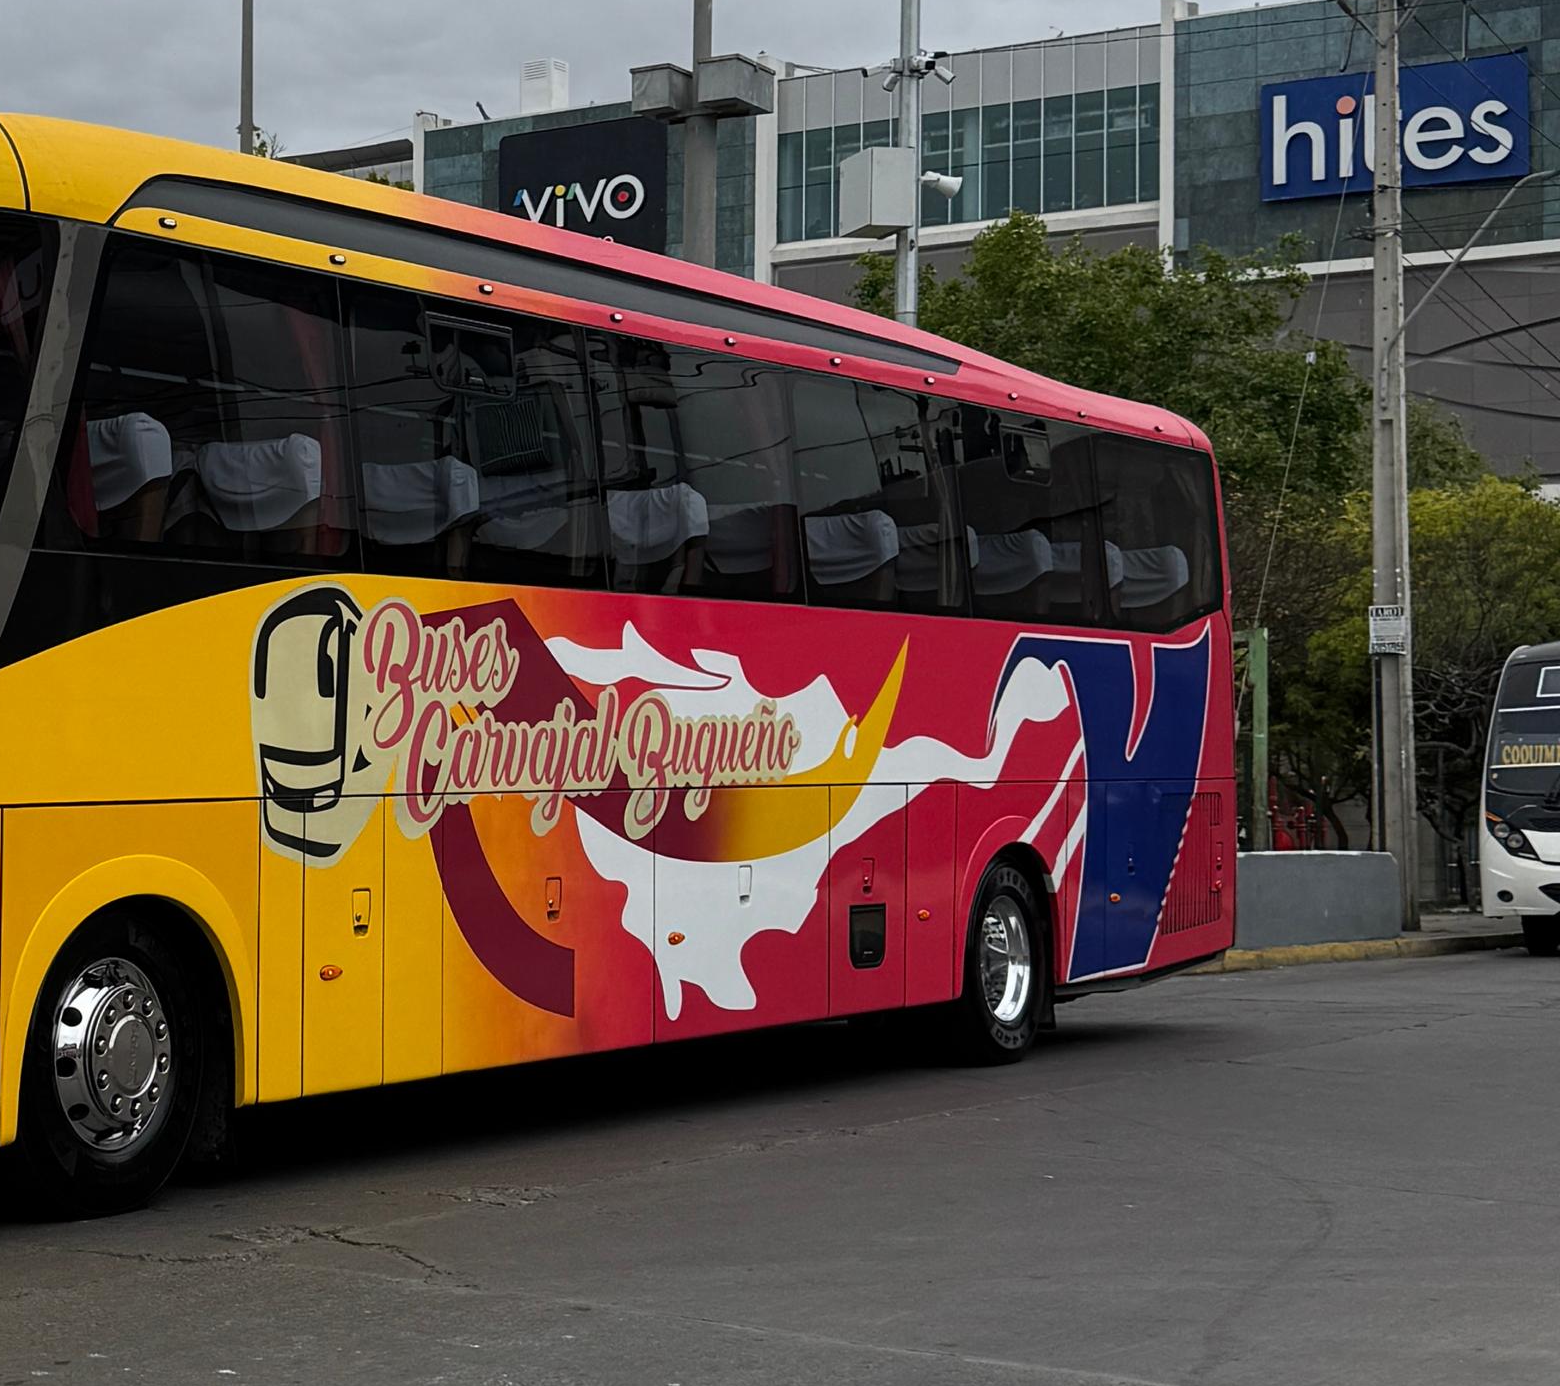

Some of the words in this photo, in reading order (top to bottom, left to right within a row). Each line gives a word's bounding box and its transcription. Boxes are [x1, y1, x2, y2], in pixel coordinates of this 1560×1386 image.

[362, 601, 517, 749] Buses
[404, 689, 618, 825] Carvajal
[624, 697, 800, 835] Bugueño
